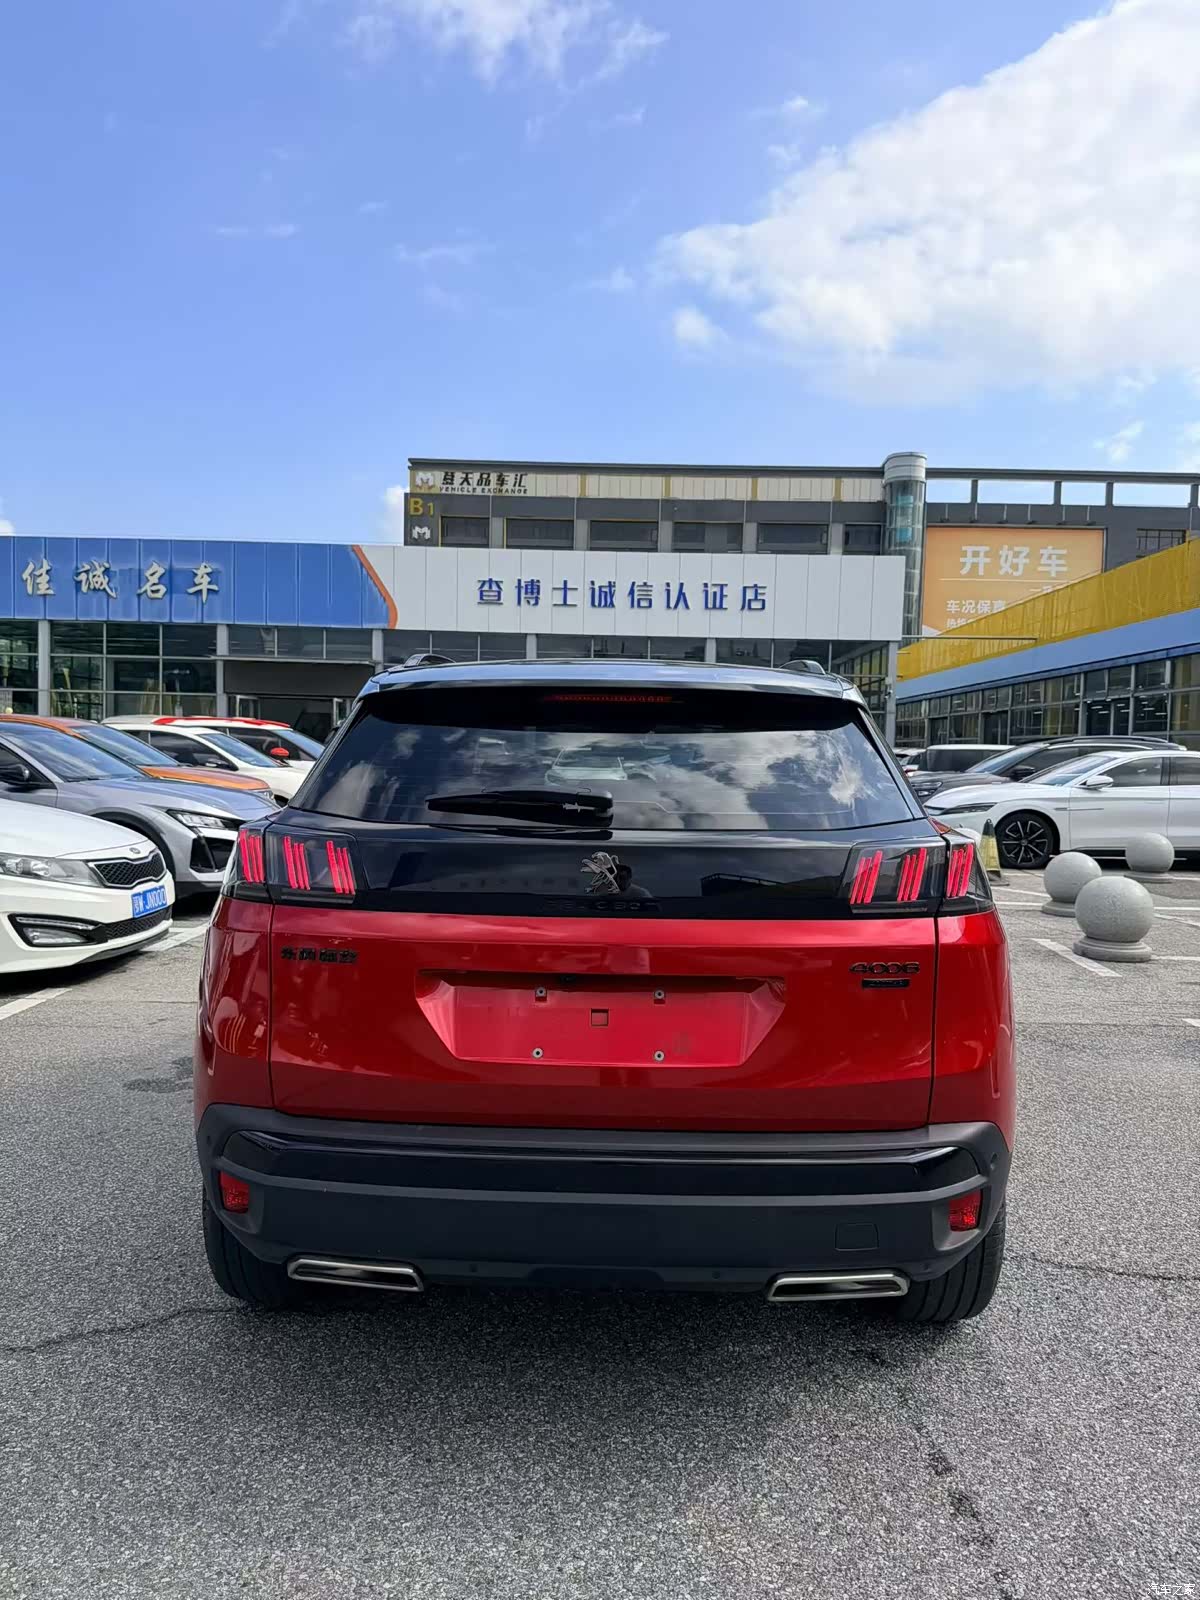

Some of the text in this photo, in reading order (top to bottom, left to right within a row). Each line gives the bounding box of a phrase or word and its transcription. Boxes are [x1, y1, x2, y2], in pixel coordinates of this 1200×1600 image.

[440, 486, 528, 495] VEHICLE EXCHANGE
[959, 544, 1069, 577] 开好车
[21, 558, 220, 604] 佳诚名车
[477, 577, 768, 612] 查博士诚信认证店
